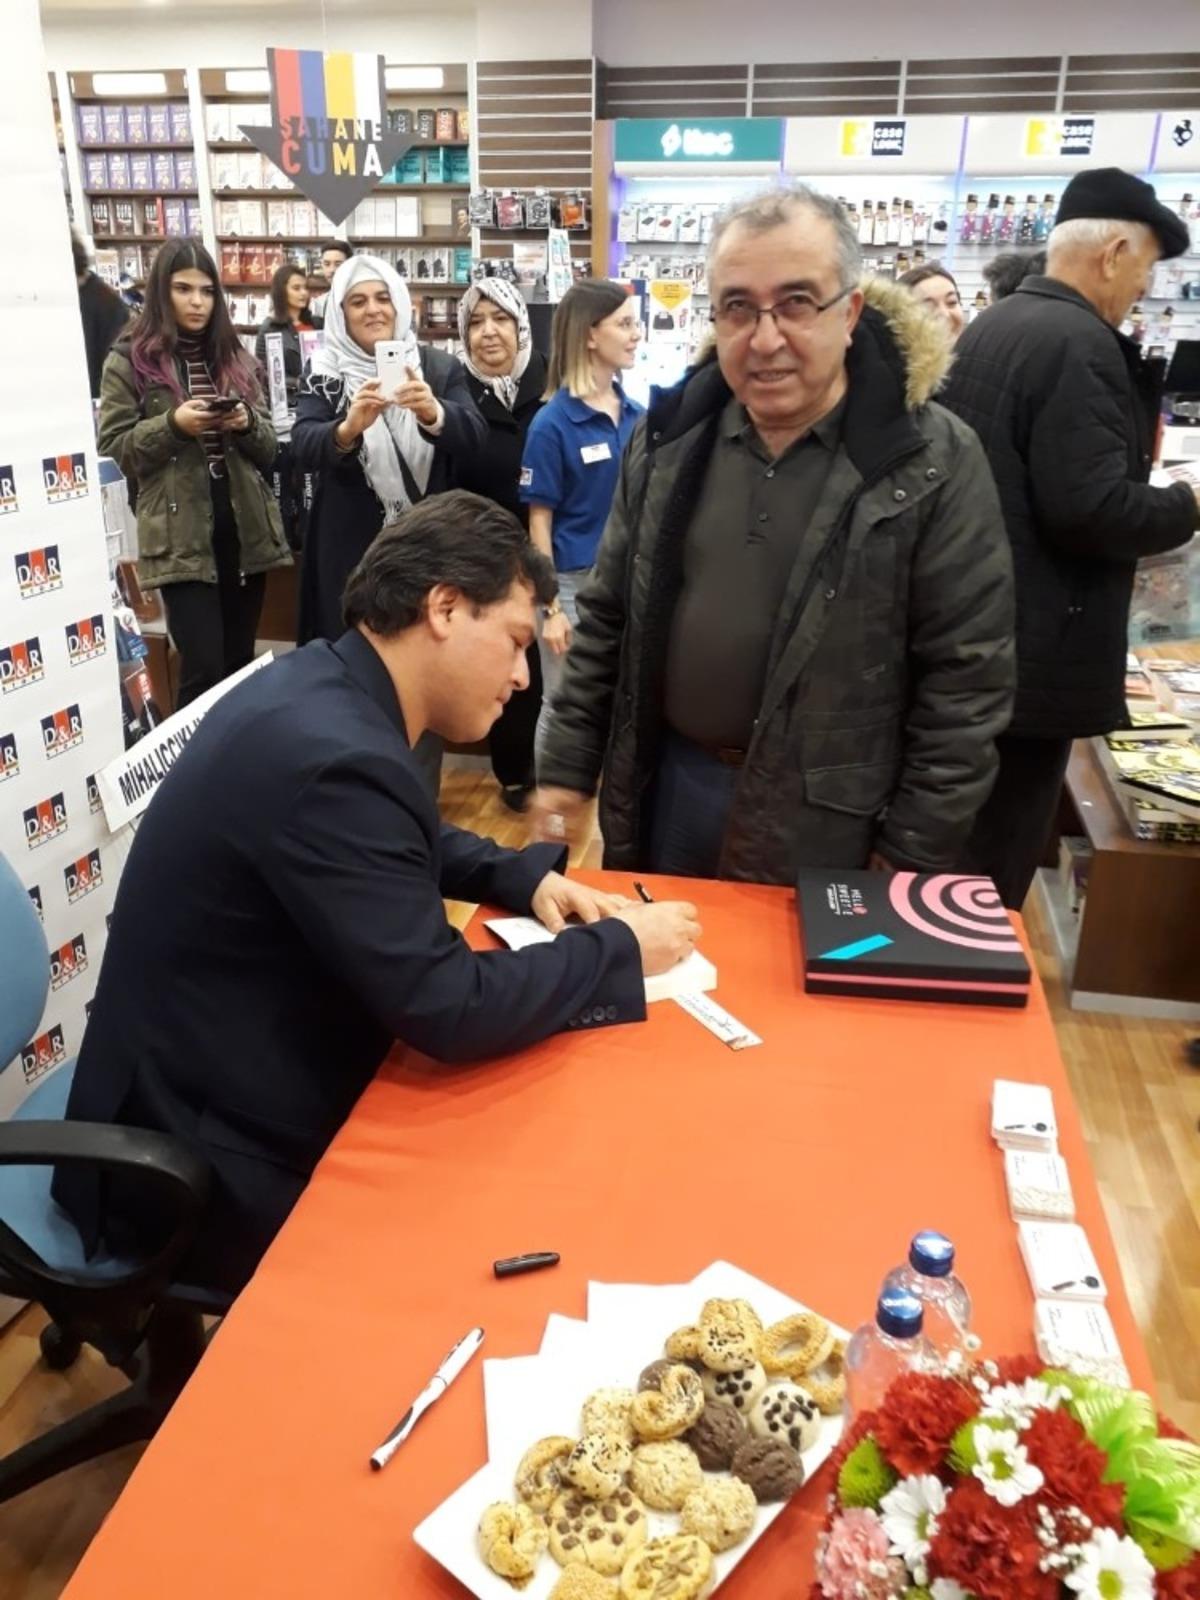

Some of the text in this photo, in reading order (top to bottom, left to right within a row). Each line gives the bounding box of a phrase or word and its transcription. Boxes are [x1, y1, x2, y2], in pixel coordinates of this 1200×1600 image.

[281, 139, 383, 177] CUMA
[45, 465, 86, 490] D&R
[17, 558, 61, 585] D&R
[68, 626, 105, 653] D&R
[0, 650, 43, 679] D&R
[44, 716, 82, 746] D&R
[27, 804, 66, 837] D&R
[67, 860, 101, 893] D&R
[51, 945, 87, 979] D&R
[23, 1036, 64, 1073] D&R
